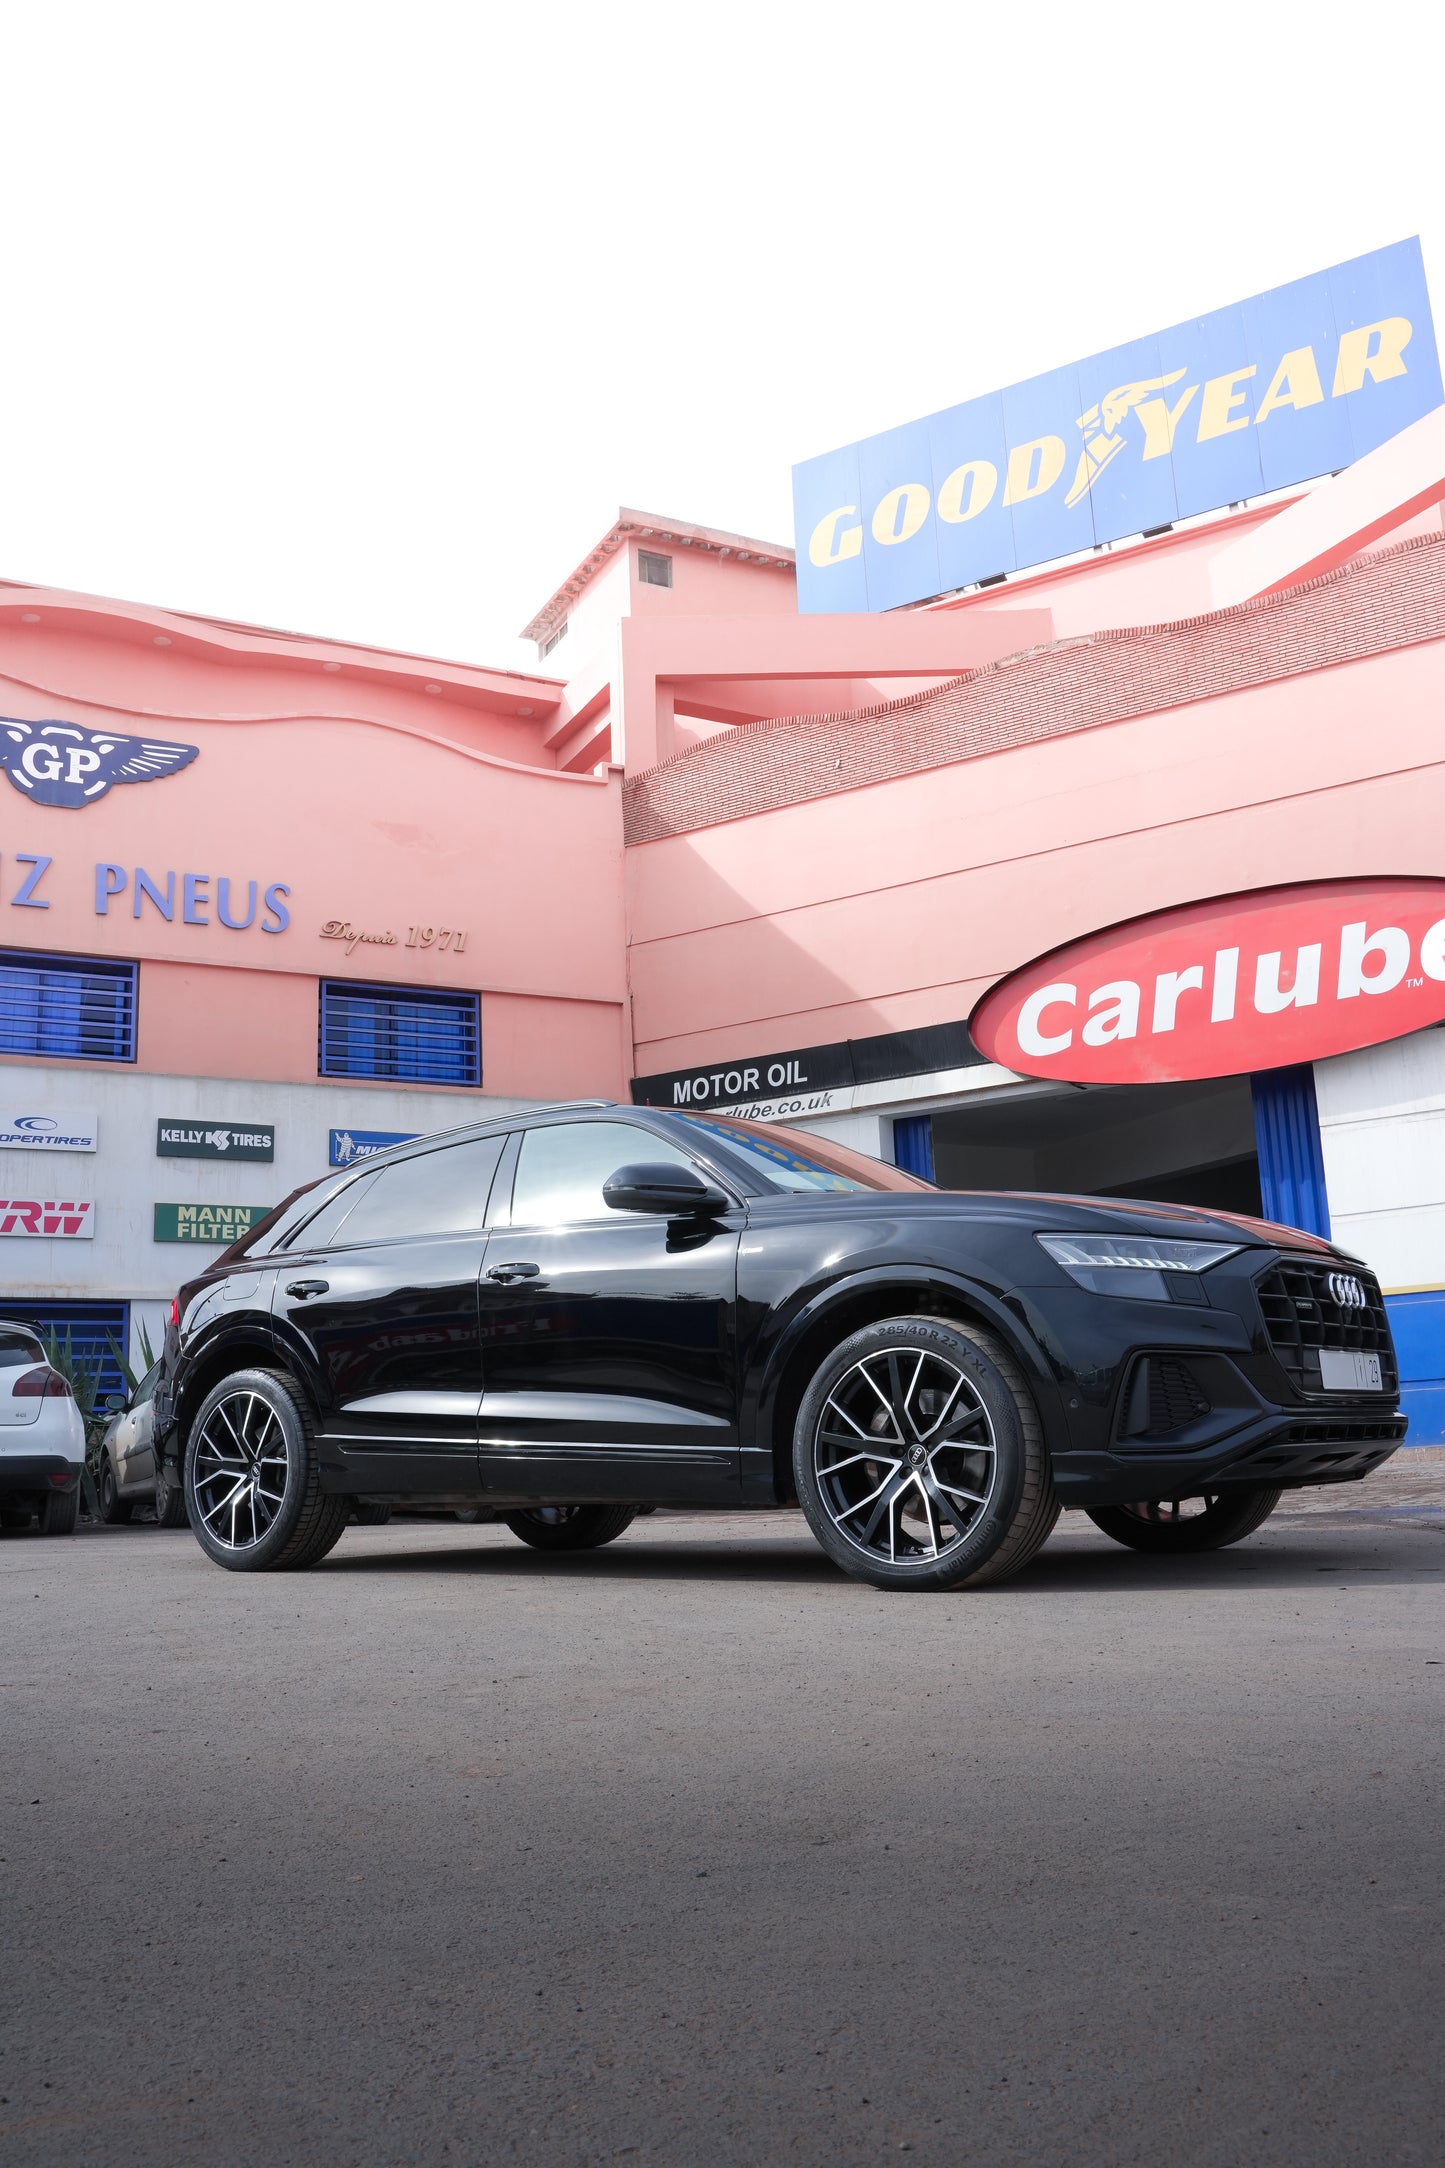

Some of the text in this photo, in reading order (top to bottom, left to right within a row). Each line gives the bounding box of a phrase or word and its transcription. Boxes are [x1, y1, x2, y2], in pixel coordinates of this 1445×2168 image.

[22, 742, 101, 785] GP
[95, 862, 291, 933] PNEUS
[319, 920, 468, 956] Depuis 1971
[673, 1061, 808, 1104] MOTOR OIL
[161, 1129, 204, 1144] KELLY
[232, 1133, 272, 1148] TIRES
[178, 1206, 251, 1223] MANN
[879, 1325, 928, 1338] 285/40
[941, 1335, 959, 1350] 22
